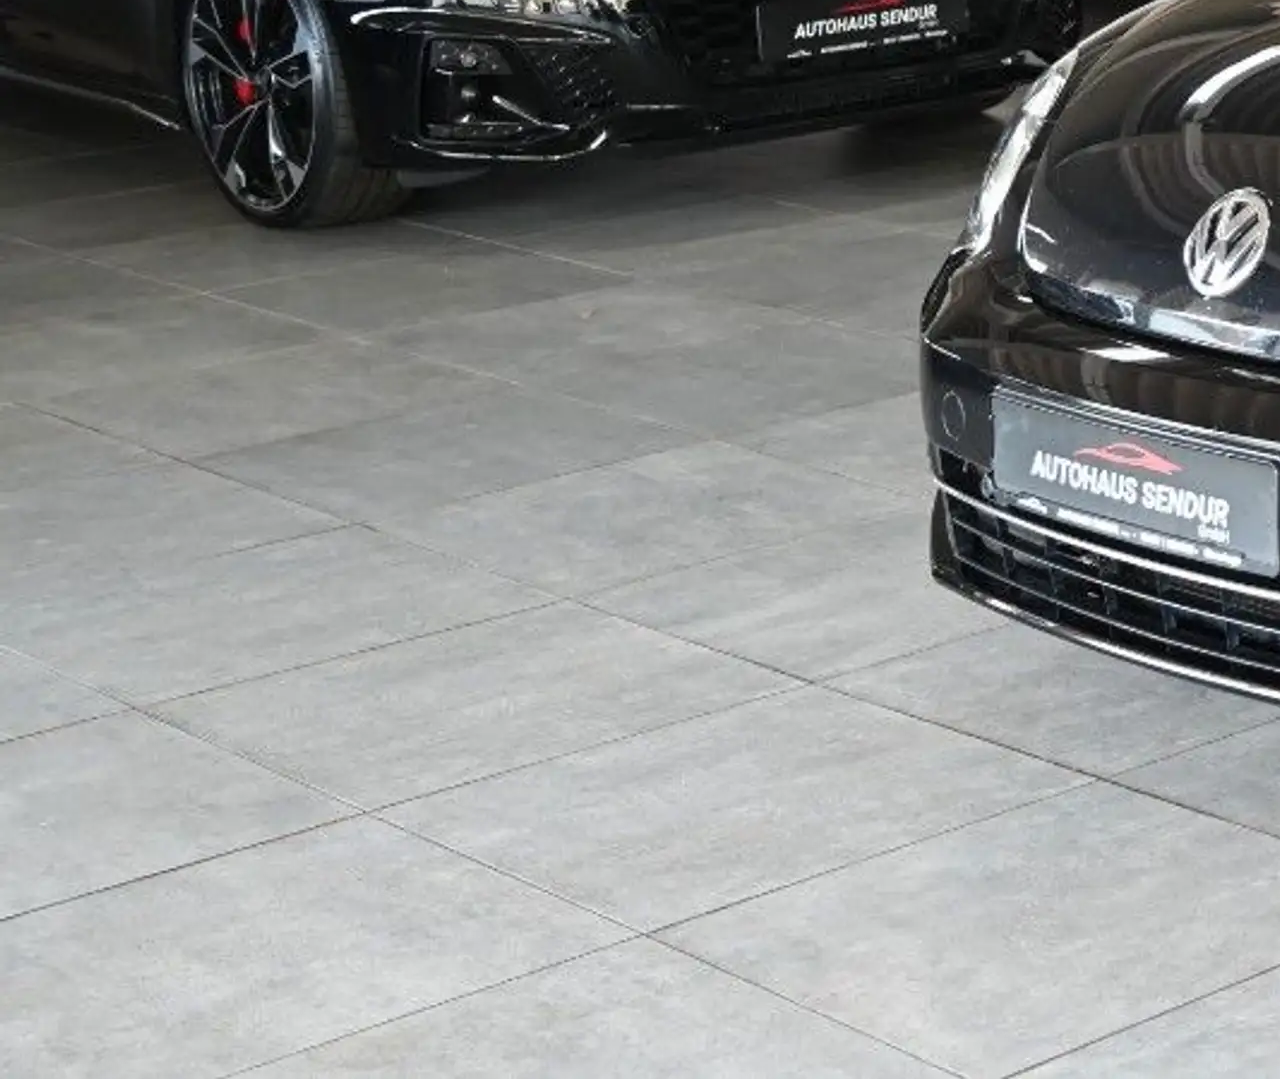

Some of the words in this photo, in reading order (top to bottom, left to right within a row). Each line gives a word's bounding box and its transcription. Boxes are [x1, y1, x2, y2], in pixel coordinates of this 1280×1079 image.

[794, 13, 877, 40] AUTOHAUS
[880, 3, 939, 28] SENDUR
[1029, 449, 1138, 505] AUTOHAUS
[1141, 480, 1231, 529] SENDUR
